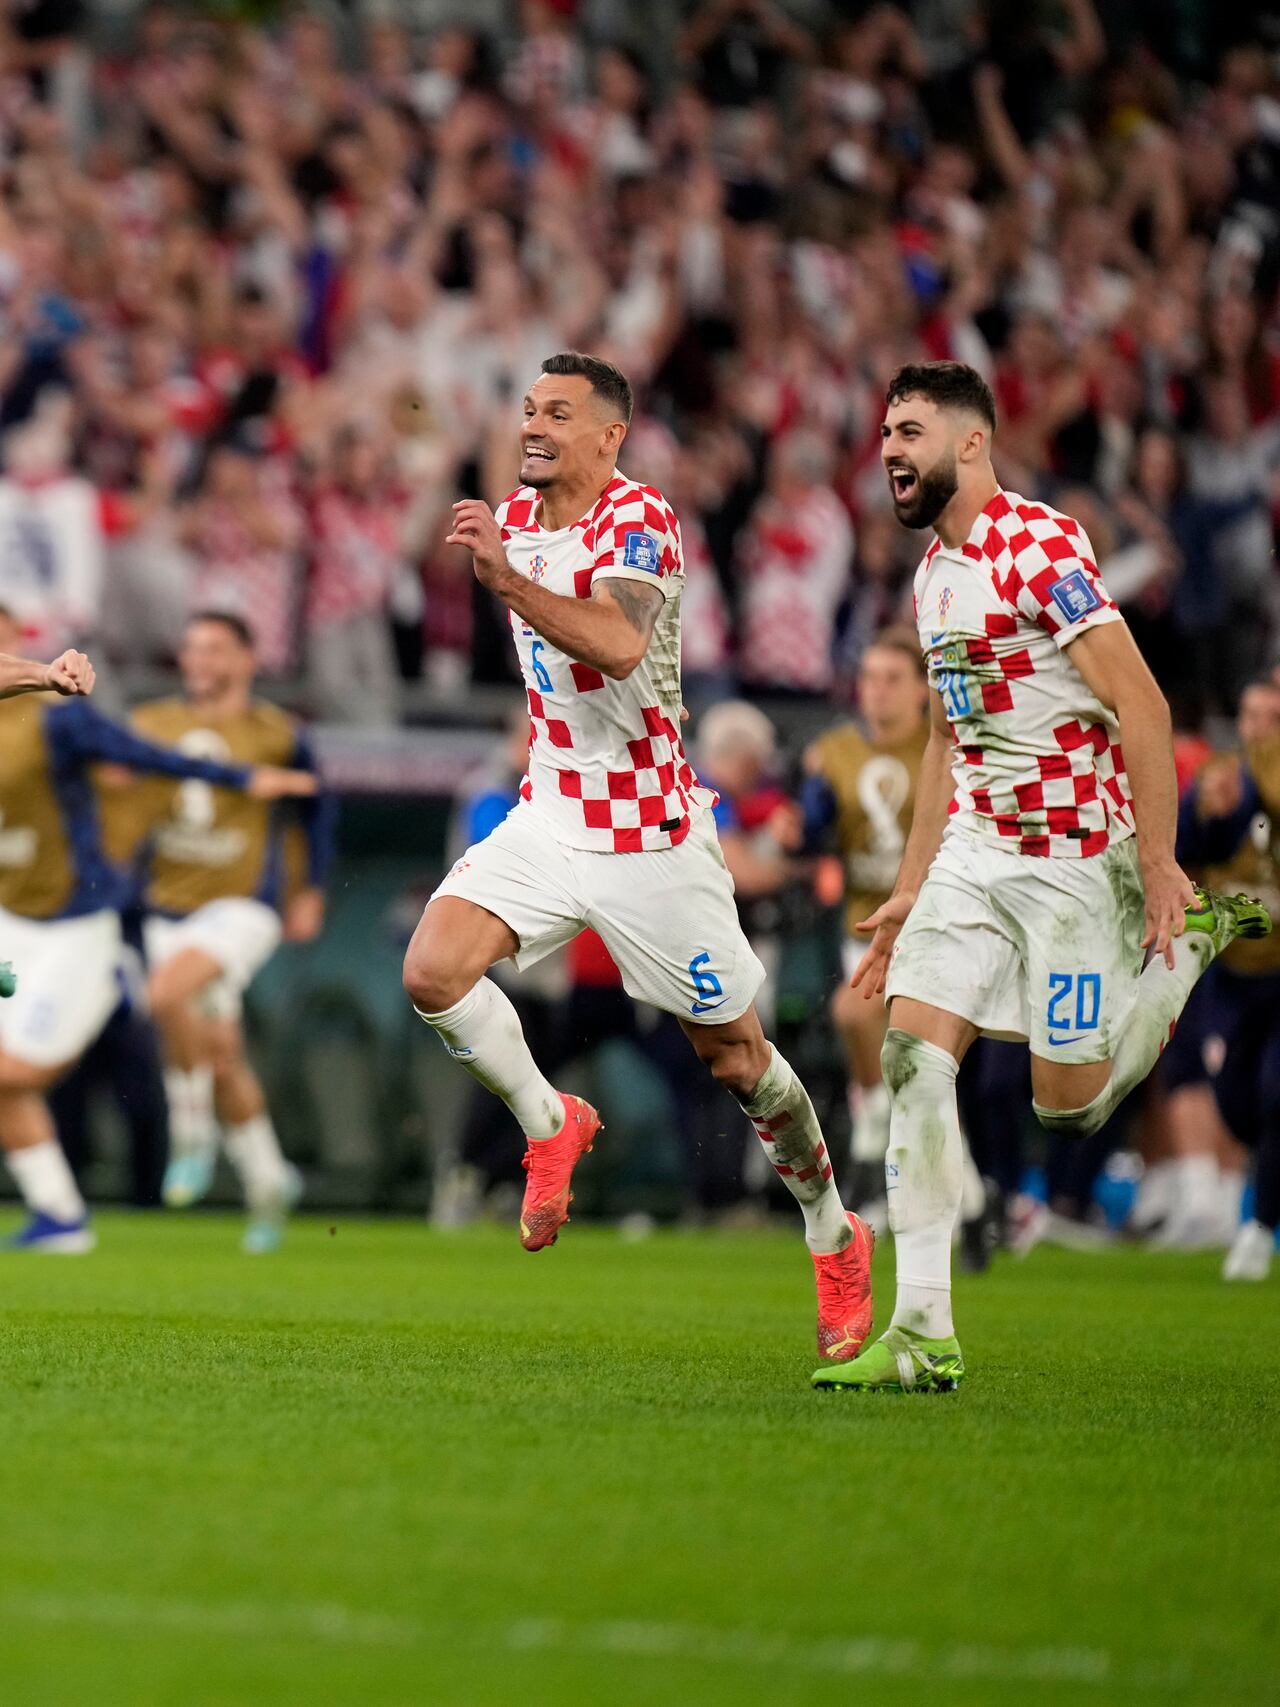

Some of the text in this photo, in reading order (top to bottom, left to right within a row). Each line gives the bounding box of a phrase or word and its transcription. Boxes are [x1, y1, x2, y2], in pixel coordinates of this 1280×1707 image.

[531, 640, 556, 693] 6
[935, 667, 973, 718] 20
[688, 950, 724, 1002] 6
[1047, 972, 1102, 1031] 20
